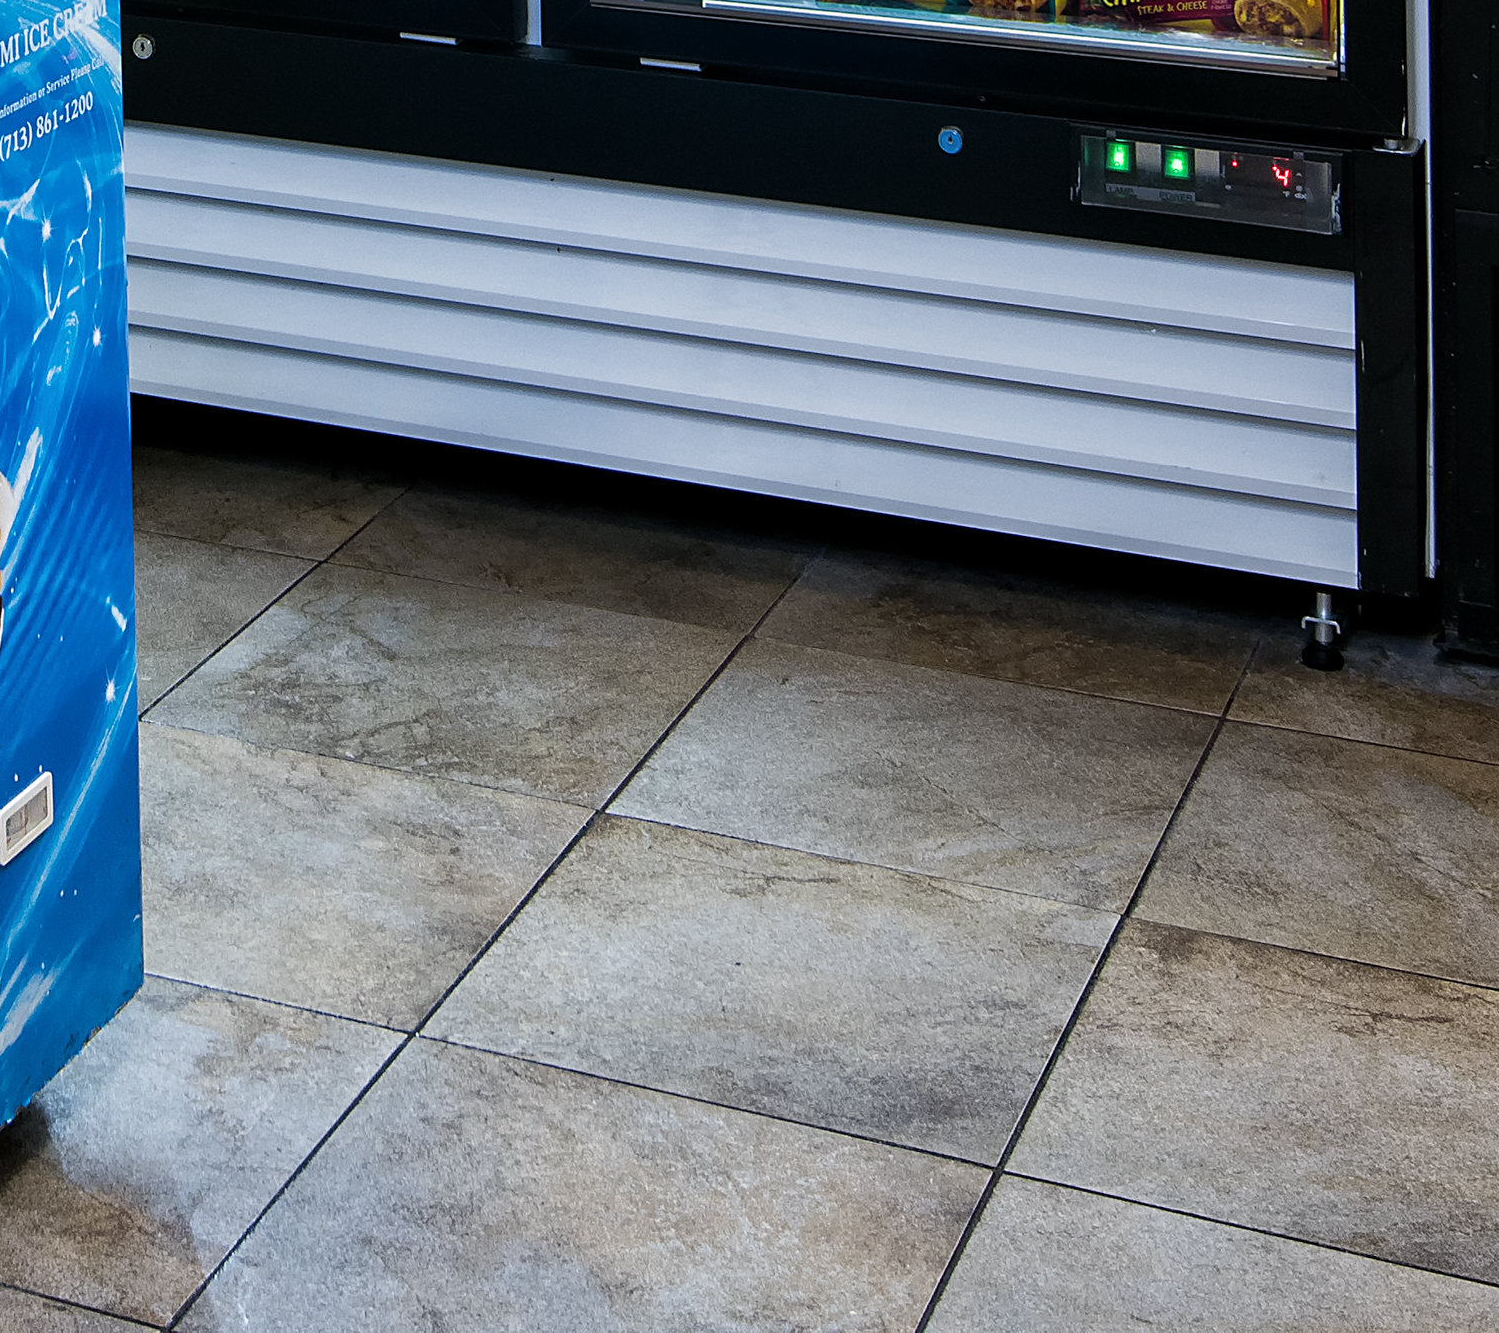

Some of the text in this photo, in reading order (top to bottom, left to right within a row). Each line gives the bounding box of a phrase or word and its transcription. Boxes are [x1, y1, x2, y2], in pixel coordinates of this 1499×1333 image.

[24, 19, 50, 56] ICE
[38, 89, 45, 100] or
[46, 73, 70, 94] Service
[71, 65, 90, 82] Please
[0, 91, 94, 162] (713) 861-1200
[1160, 193, 1193, 202] POWER
